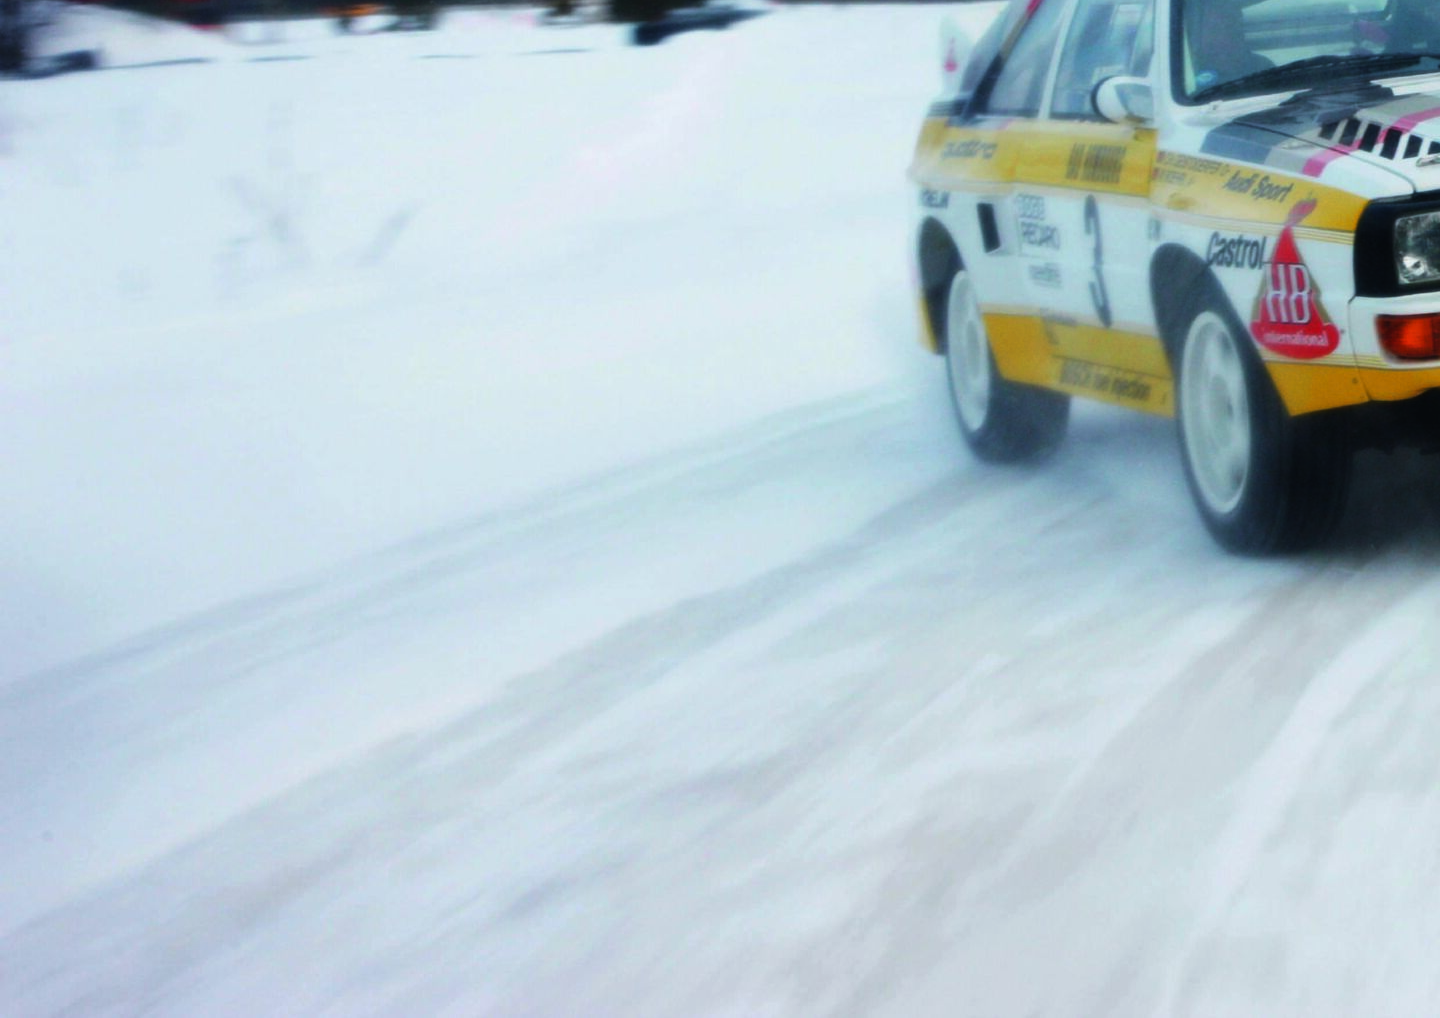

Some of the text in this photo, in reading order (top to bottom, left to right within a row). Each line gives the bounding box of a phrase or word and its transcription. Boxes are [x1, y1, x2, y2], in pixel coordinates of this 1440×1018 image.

[1222, 169, 1260, 194] Audi
[1252, 175, 1294, 204] Sport
[1206, 231, 1267, 270] Castrol
[1265, 263, 1312, 324] HB
[1262, 331, 1330, 348] international
